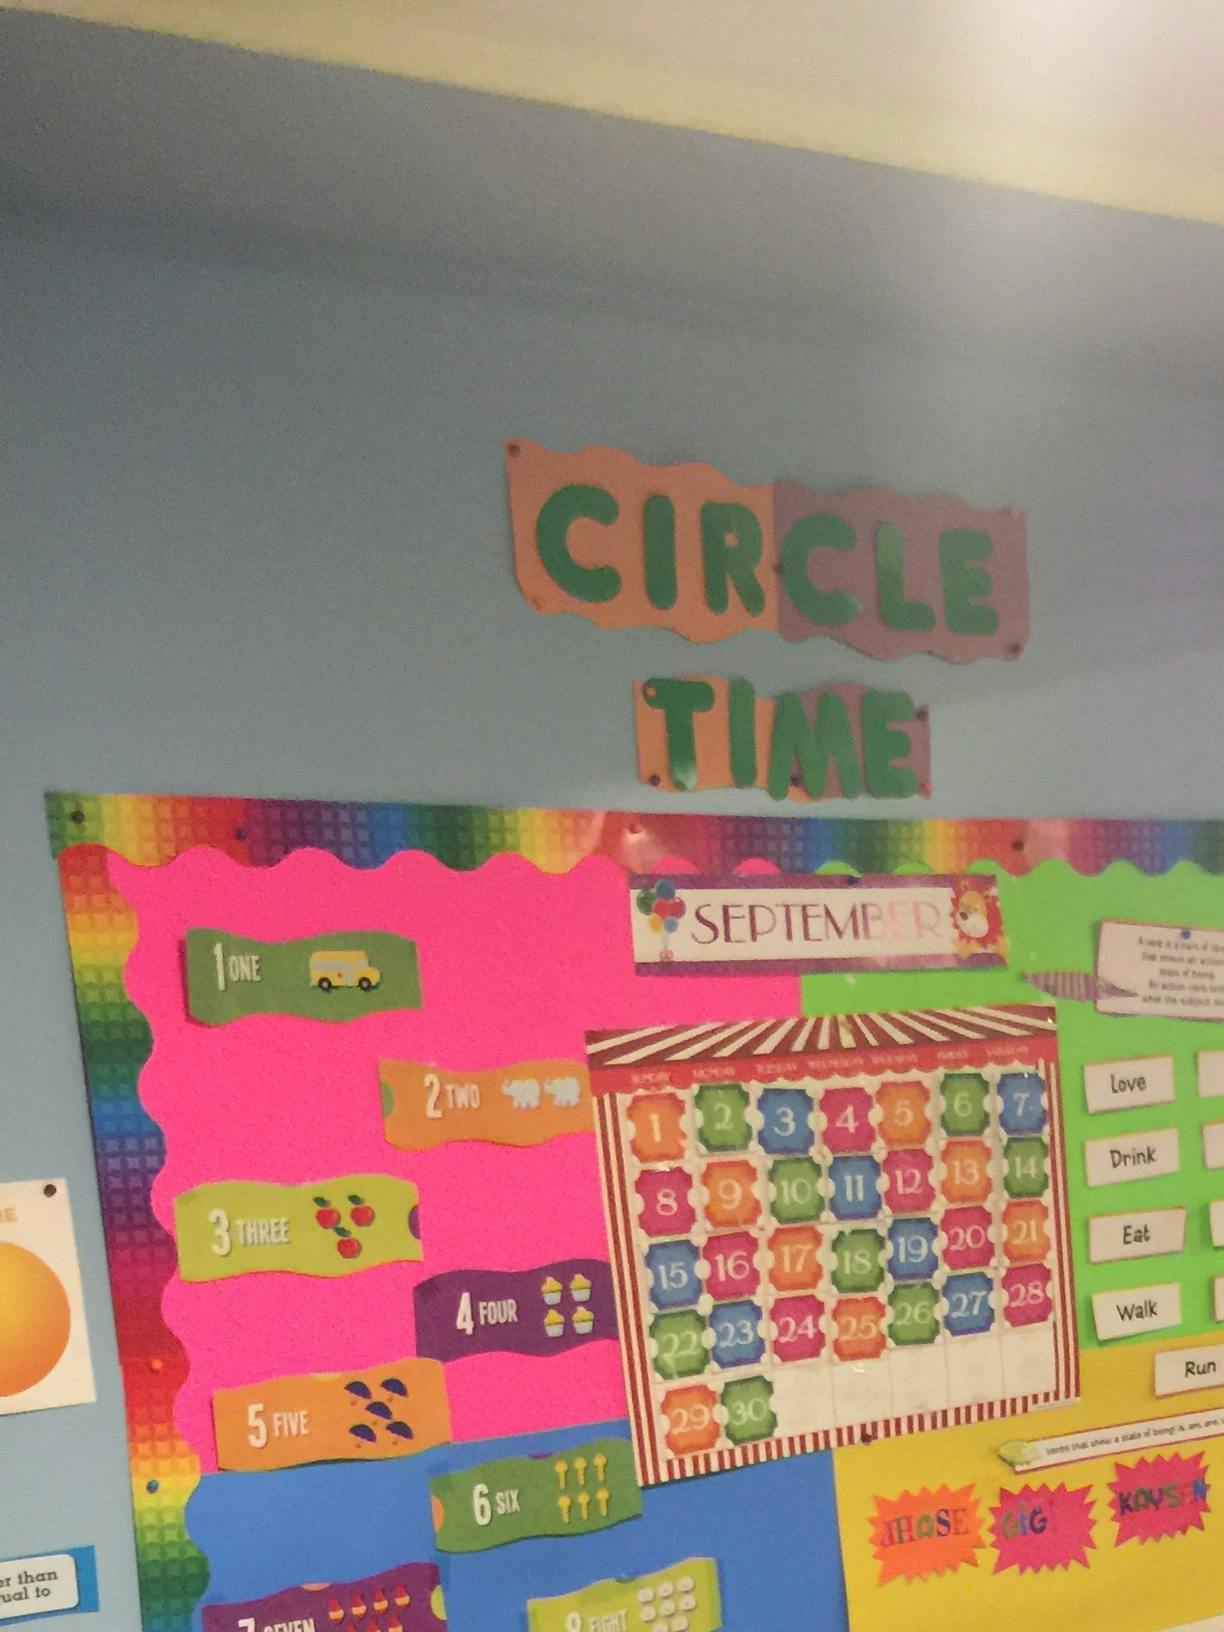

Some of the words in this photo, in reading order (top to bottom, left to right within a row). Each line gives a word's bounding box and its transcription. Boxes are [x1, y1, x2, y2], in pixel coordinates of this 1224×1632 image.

[536, 483, 999, 636] CIRCLE
[643, 676, 920, 800] TIME
[691, 902, 942, 945] SEPTEMBER
[214, 942, 226, 990] 1
[229, 955, 261, 982] ONE
[425, 1074, 442, 1119] 2
[446, 1083, 480, 1109] TWO
[1110, 1074, 1146, 1094] Love
[650, 1114, 661, 1143] 1
[714, 1103, 733, 1129] 2
[774, 1108, 796, 1136] 3
[837, 1105, 859, 1133] 4
[894, 1097, 912, 1125] 5
[953, 1092, 972, 1117] 6
[1013, 1091, 1028, 1116] 7
[1110, 1147, 1157, 1168] Drink
[656, 1188, 678, 1216] 8
[718, 1180, 741, 1208] 9
[781, 1177, 812, 1204] 10
[844, 1174, 863, 1201] 11
[895, 1168, 922, 1195] 12
[952, 1159, 978, 1185] 13
[1014, 1155, 1038, 1179] 14
[208, 1209, 230, 1256] 3
[236, 1218, 289, 1245] THREE
[1123, 1225, 1150, 1245] Eat
[658, 1261, 688, 1291] 15
[715, 1252, 749, 1281] 16
[782, 1244, 810, 1273] 17
[844, 1246, 872, 1274] 18
[898, 1236, 929, 1264] 19
[950, 1225, 987, 1251] 20
[1012, 1219, 1039, 1244] 21
[455, 1292, 474, 1335] 4
[479, 1300, 518, 1325] FOUR
[663, 1330, 699, 1359] 22
[719, 1316, 753, 1346] 23
[781, 1312, 818, 1342] 24
[841, 1313, 877, 1339] 25
[898, 1298, 931, 1325] 26
[951, 1290, 986, 1317] 27
[1009, 1283, 1043, 1306] 28
[1117, 1300, 1157, 1321] Walk
[1185, 1360, 1216, 1377] Run
[247, 1403, 267, 1448] 5
[273, 1411, 310, 1440] FIVE
[671, 1401, 710, 1431] 29
[729, 1398, 768, 1424] 30
[473, 1483, 492, 1525] 6
[496, 1489, 521, 1515] SIX
[18, 1567, 58, 1584] than
[35, 1585, 51, 1598] to
